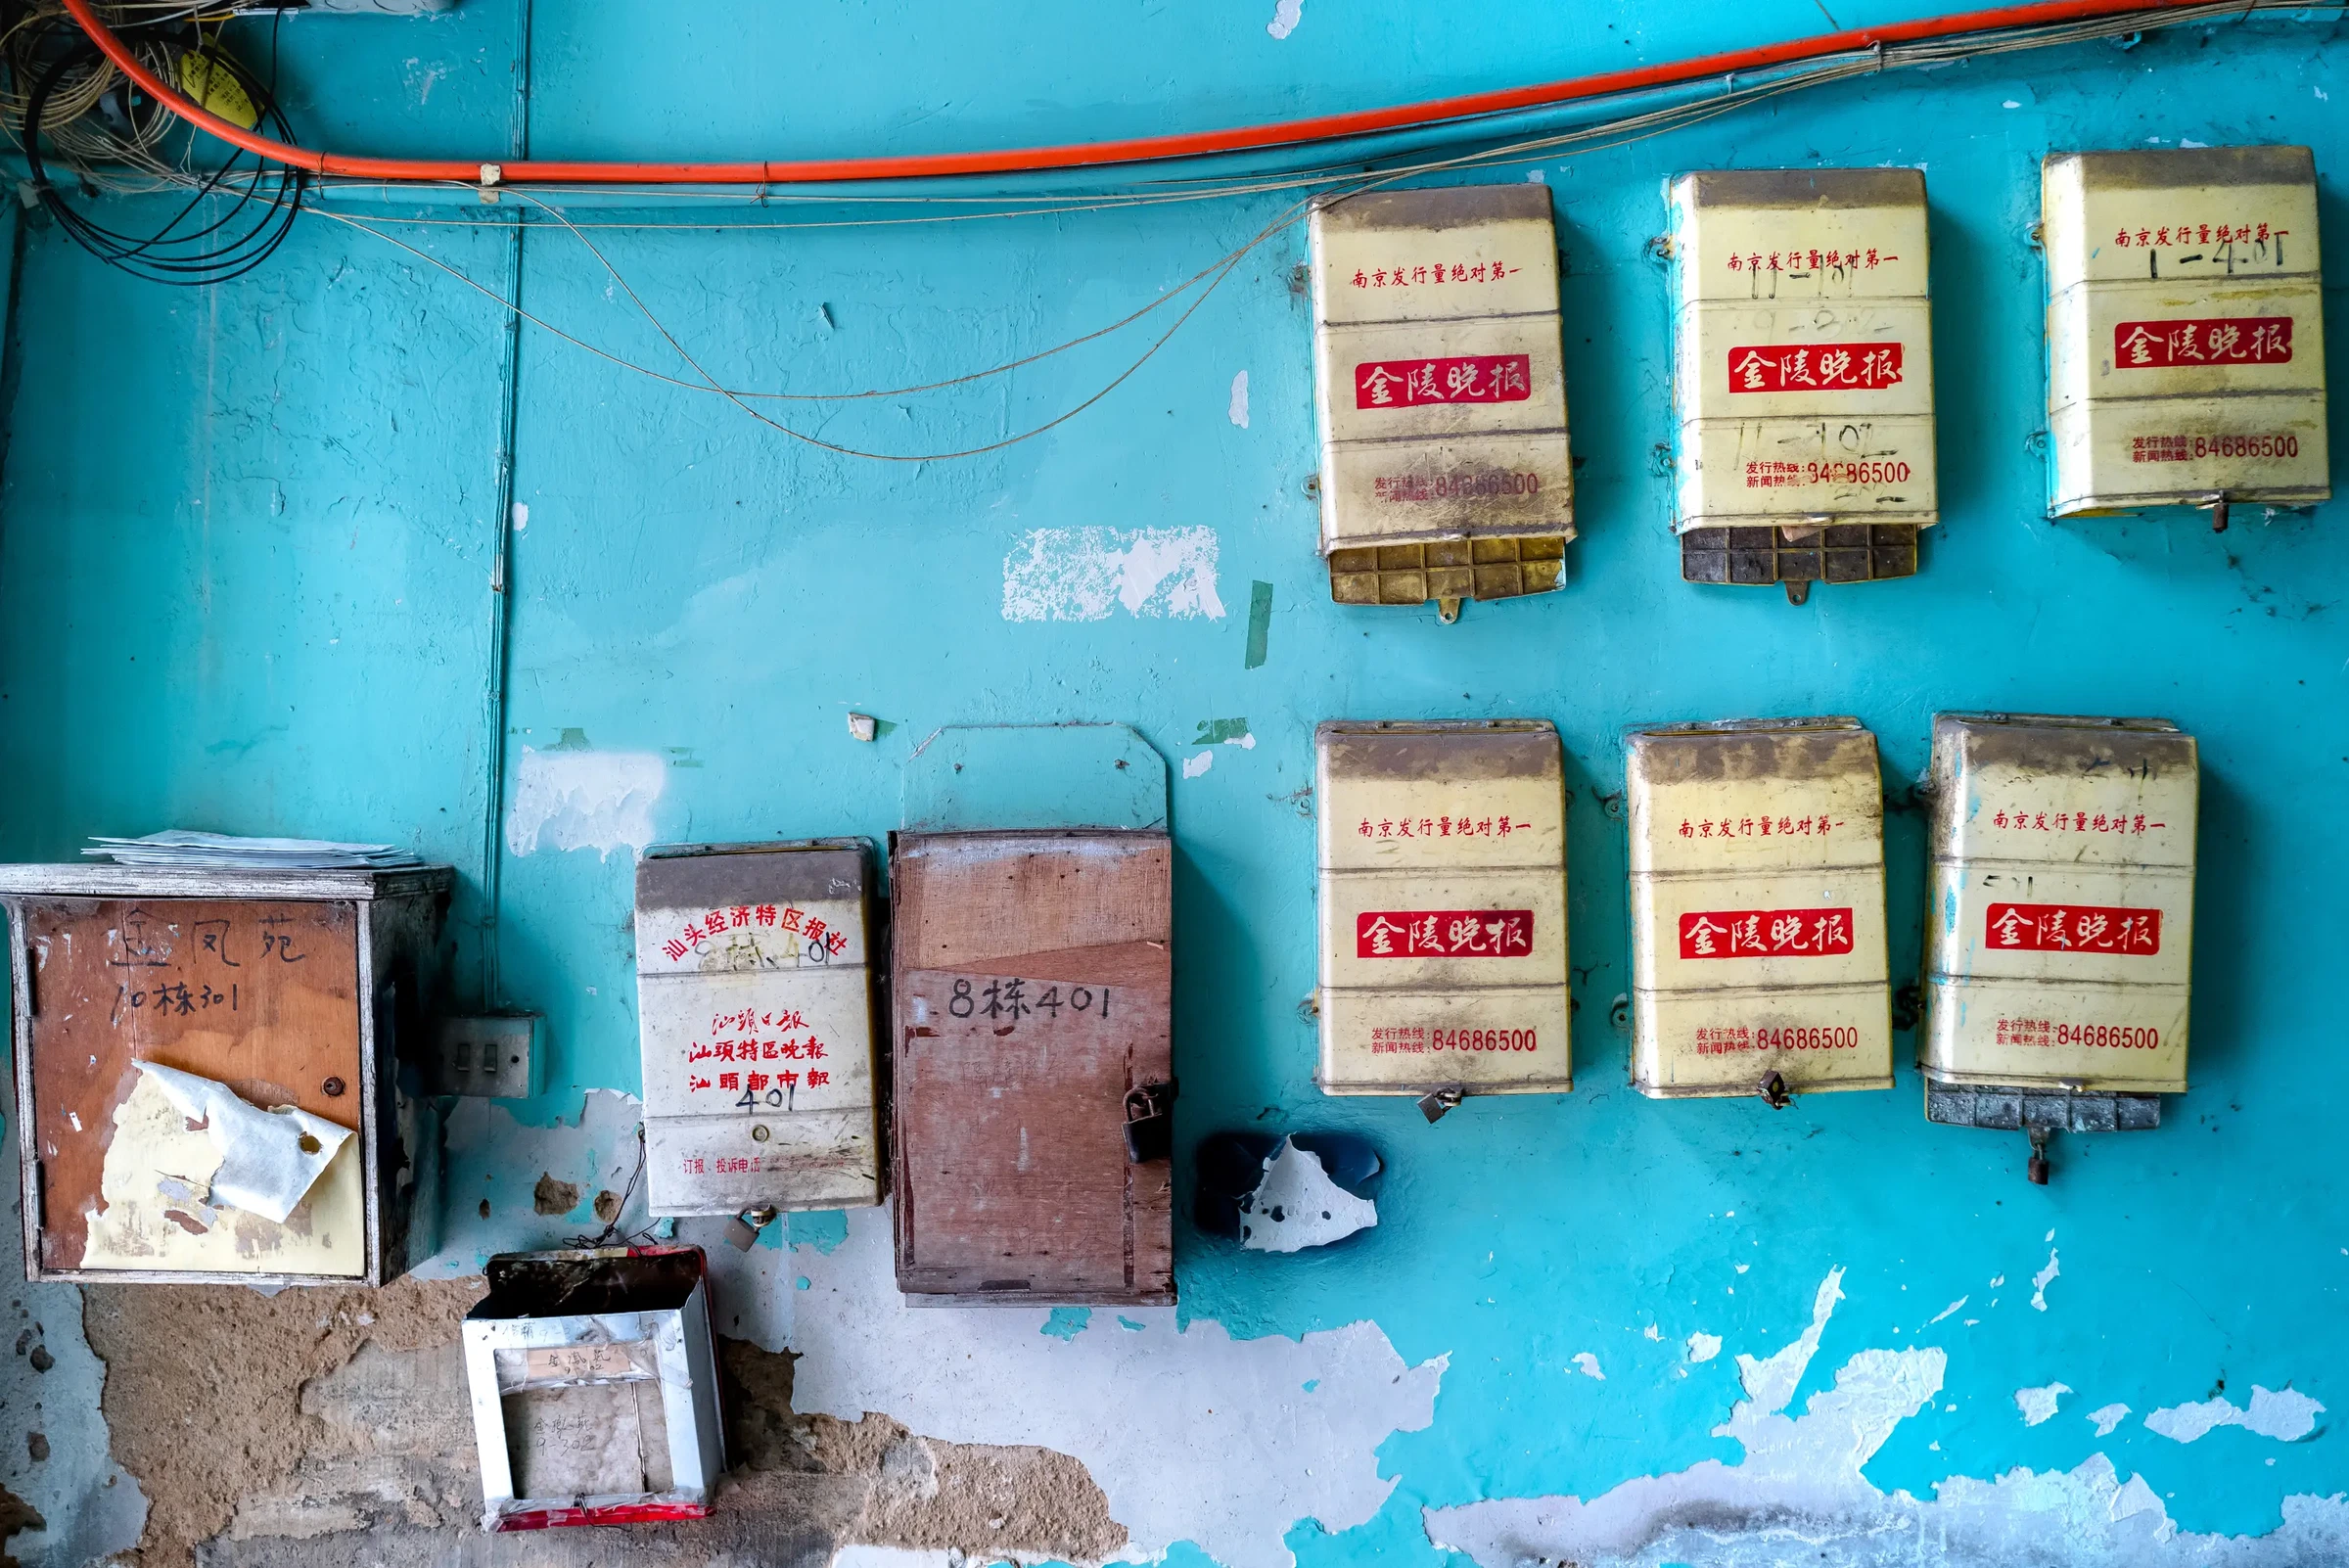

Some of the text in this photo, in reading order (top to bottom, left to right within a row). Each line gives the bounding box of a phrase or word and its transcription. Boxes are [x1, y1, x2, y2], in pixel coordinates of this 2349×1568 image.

[2115, 223, 2289, 249] 南京发行量绝对第一
[1727, 248, 1899, 272] 南京发行量绝对第一
[1353, 260, 1523, 288] 南京发行量绝对第一
[2120, 324, 2287, 363] 金陵晚报
[1733, 349, 1897, 389] 金陵晚报
[1360, 360, 1528, 405] 金陵晚报
[2132, 437, 2193, 449] 发行热线:
[2195, 436, 2298, 458] 84686500
[1745, 461, 1806, 474] 发行热线:
[2132, 449, 2193, 463] 新闻热线:
[1358, 814, 1533, 839] 南京发行量绝对第一
[1679, 814, 1845, 839] 南京发行量绝对第一
[1993, 809, 2166, 836] 南京发行量绝对第一
[662, 903, 848, 962] 汕头经济特区报社
[1361, 914, 1527, 954] 金陵晚报
[1684, 914, 1849, 955] 金陵晚报
[1992, 907, 2152, 950] 金陵晚报
[110, 982, 238, 1022] 10栋301
[949, 978, 1110, 1020] 8栋401
[1371, 1027, 1431, 1040] 发行热线:
[1696, 1027, 1756, 1040] 发行热线:
[1757, 1026, 1858, 1050] 84686500
[1997, 1018, 2056, 1033] 发行热线:
[2056, 1023, 2159, 1049] 84686500
[1371, 1041, 1431, 1054] 新闻热线:
[1432, 1028, 1537, 1052] 84686500
[1995, 1033, 2055, 1047] 新闻热线:
[735, 1083, 795, 1115] 401
[683, 1157, 705, 1175] 订报
[715, 1156, 761, 1175] 投诉电话
[535, 1434, 596, 1457] 9-302
